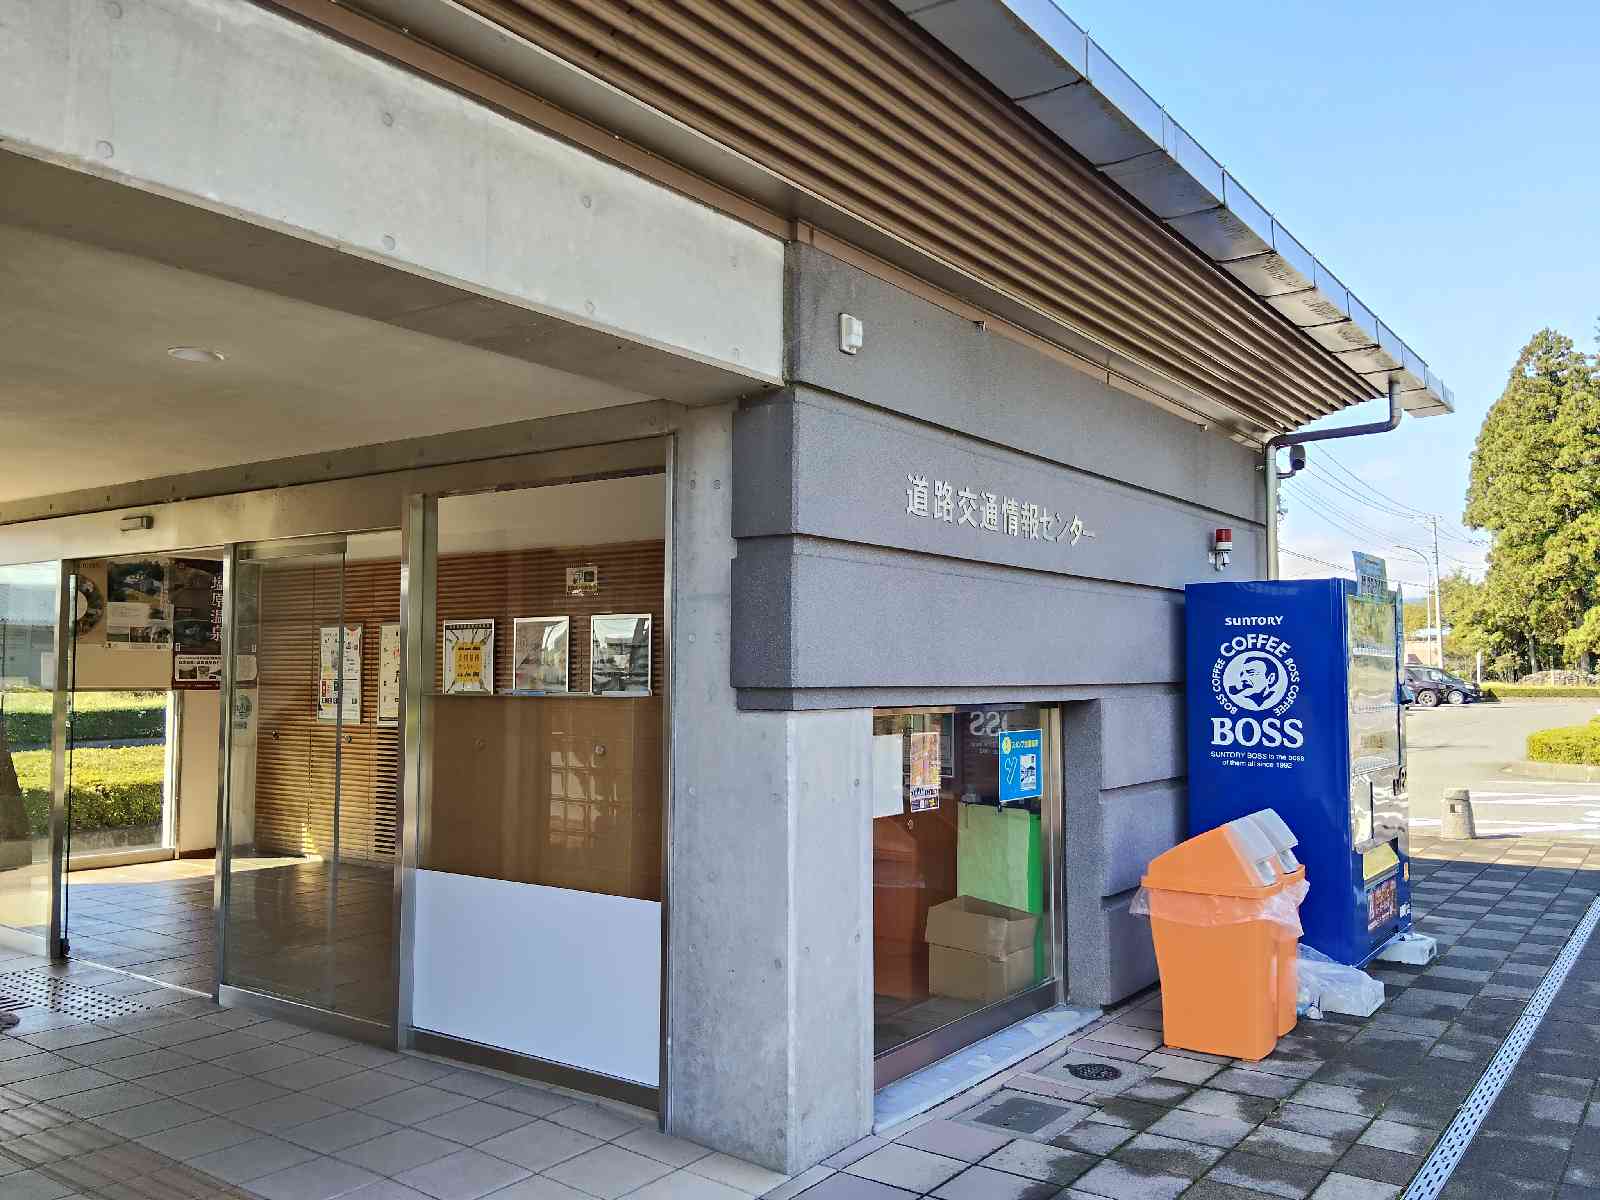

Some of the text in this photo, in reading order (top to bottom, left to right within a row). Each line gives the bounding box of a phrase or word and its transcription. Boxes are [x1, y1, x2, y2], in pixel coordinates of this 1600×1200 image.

[905, 472, 1096, 546] 道路交通情報センター
[1220, 633, 1292, 658] COFFEE
[1211, 657, 1239, 715] BOSS COFFEE
[1273, 657, 1300, 717] BOSS COFFEE
[1210, 717, 1304, 749] BOSS
[1210, 750, 1246, 759] SUNTORY
[1247, 752, 1268, 760] BOSS
